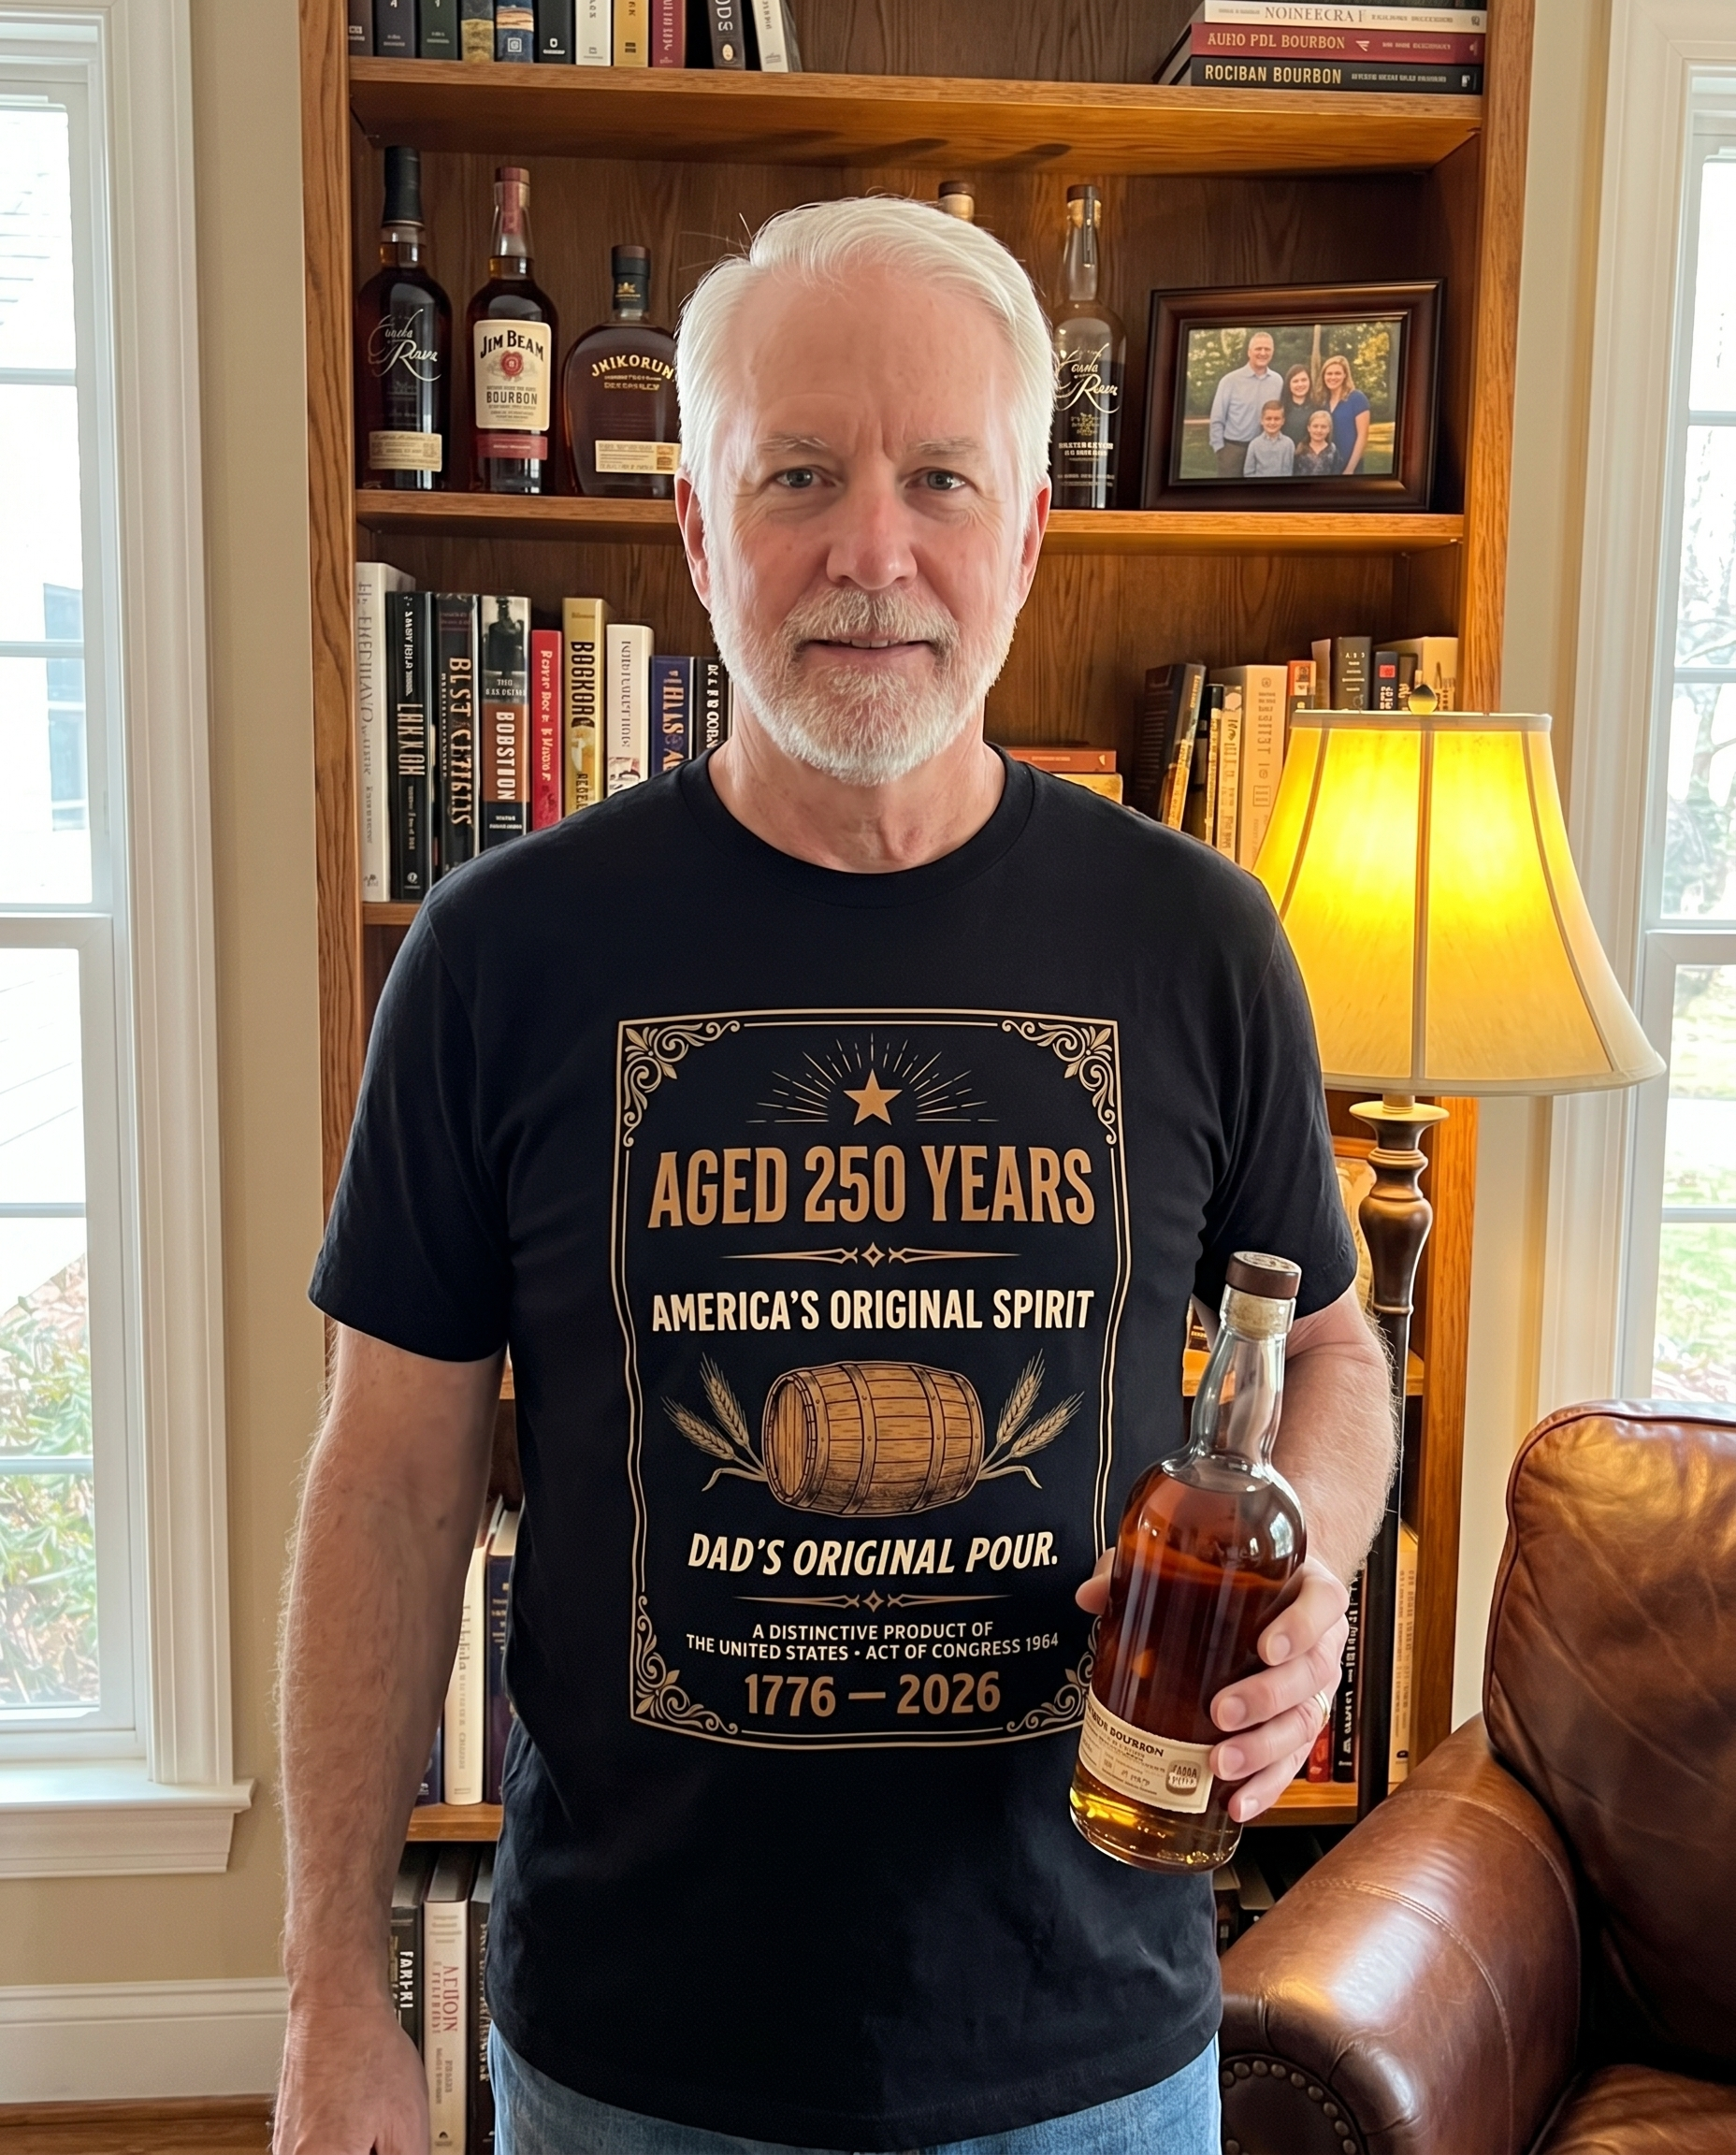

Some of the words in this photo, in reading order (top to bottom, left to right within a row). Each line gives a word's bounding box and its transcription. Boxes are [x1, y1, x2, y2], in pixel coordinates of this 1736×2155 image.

[1281, 35, 1346, 50] BOURBON
[1205, 65, 1267, 82] ROCIBAN
[1273, 66, 1342, 85] BOURBON
[480, 336, 503, 359] JIM
[507, 330, 543, 362] BEAM
[486, 391, 538, 405] BOURBON
[648, 1147, 787, 1228] AGED
[803, 1144, 905, 1222] 250
[920, 1145, 1095, 1225] YEARS
[652, 1290, 819, 1331] AMERICA'S
[830, 1289, 983, 1330] ORIGINAL
[992, 1289, 1095, 1329] SPIRIT
[687, 1532, 784, 1576] DAD'S
[792, 1538, 955, 1576] ORIGINAL
[964, 1531, 1058, 1573] POUR.
[686, 1633, 715, 1653] THE
[719, 1639, 782, 1659] UNITED
[786, 1645, 849, 1661] STATES
[865, 1644, 900, 1660] ACT
[904, 1643, 928, 1659] OF
[932, 1639, 1020, 1658] CONGRESS
[1025, 1632, 1059, 1652] 1964
[752, 1623, 765, 1639] A
[769, 1624, 878, 1642] DISTINCTIVE
[884, 1622, 967, 1640] PRODUCT
[971, 1621, 993, 1637] OF
[745, 1673, 836, 1717] 1776
[897, 1671, 1001, 1714] 2026
